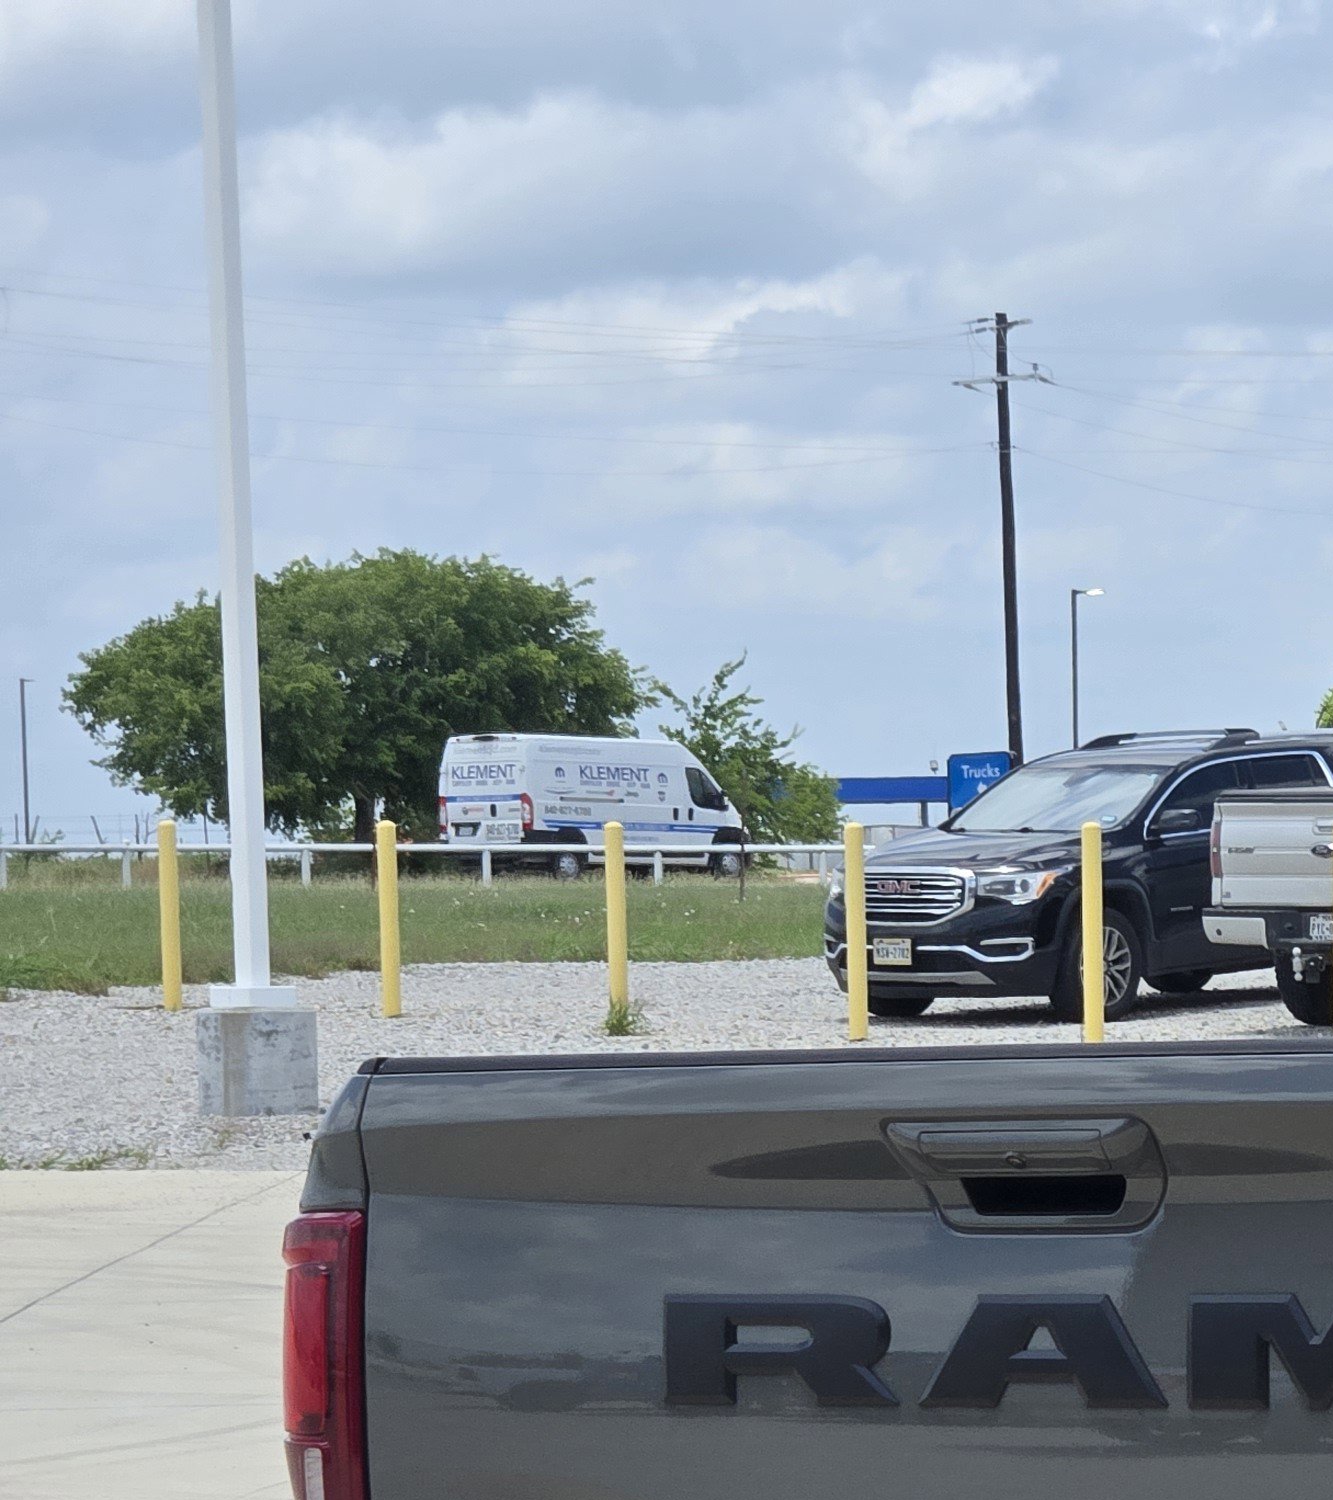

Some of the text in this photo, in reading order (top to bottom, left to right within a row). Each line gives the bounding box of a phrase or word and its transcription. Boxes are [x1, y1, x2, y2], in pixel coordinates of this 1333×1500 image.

[451, 764, 516, 780] KLEMENT
[579, 765, 650, 782] KLEMENT
[960, 763, 1001, 779] Trucks
[877, 880, 921, 894] GMC
